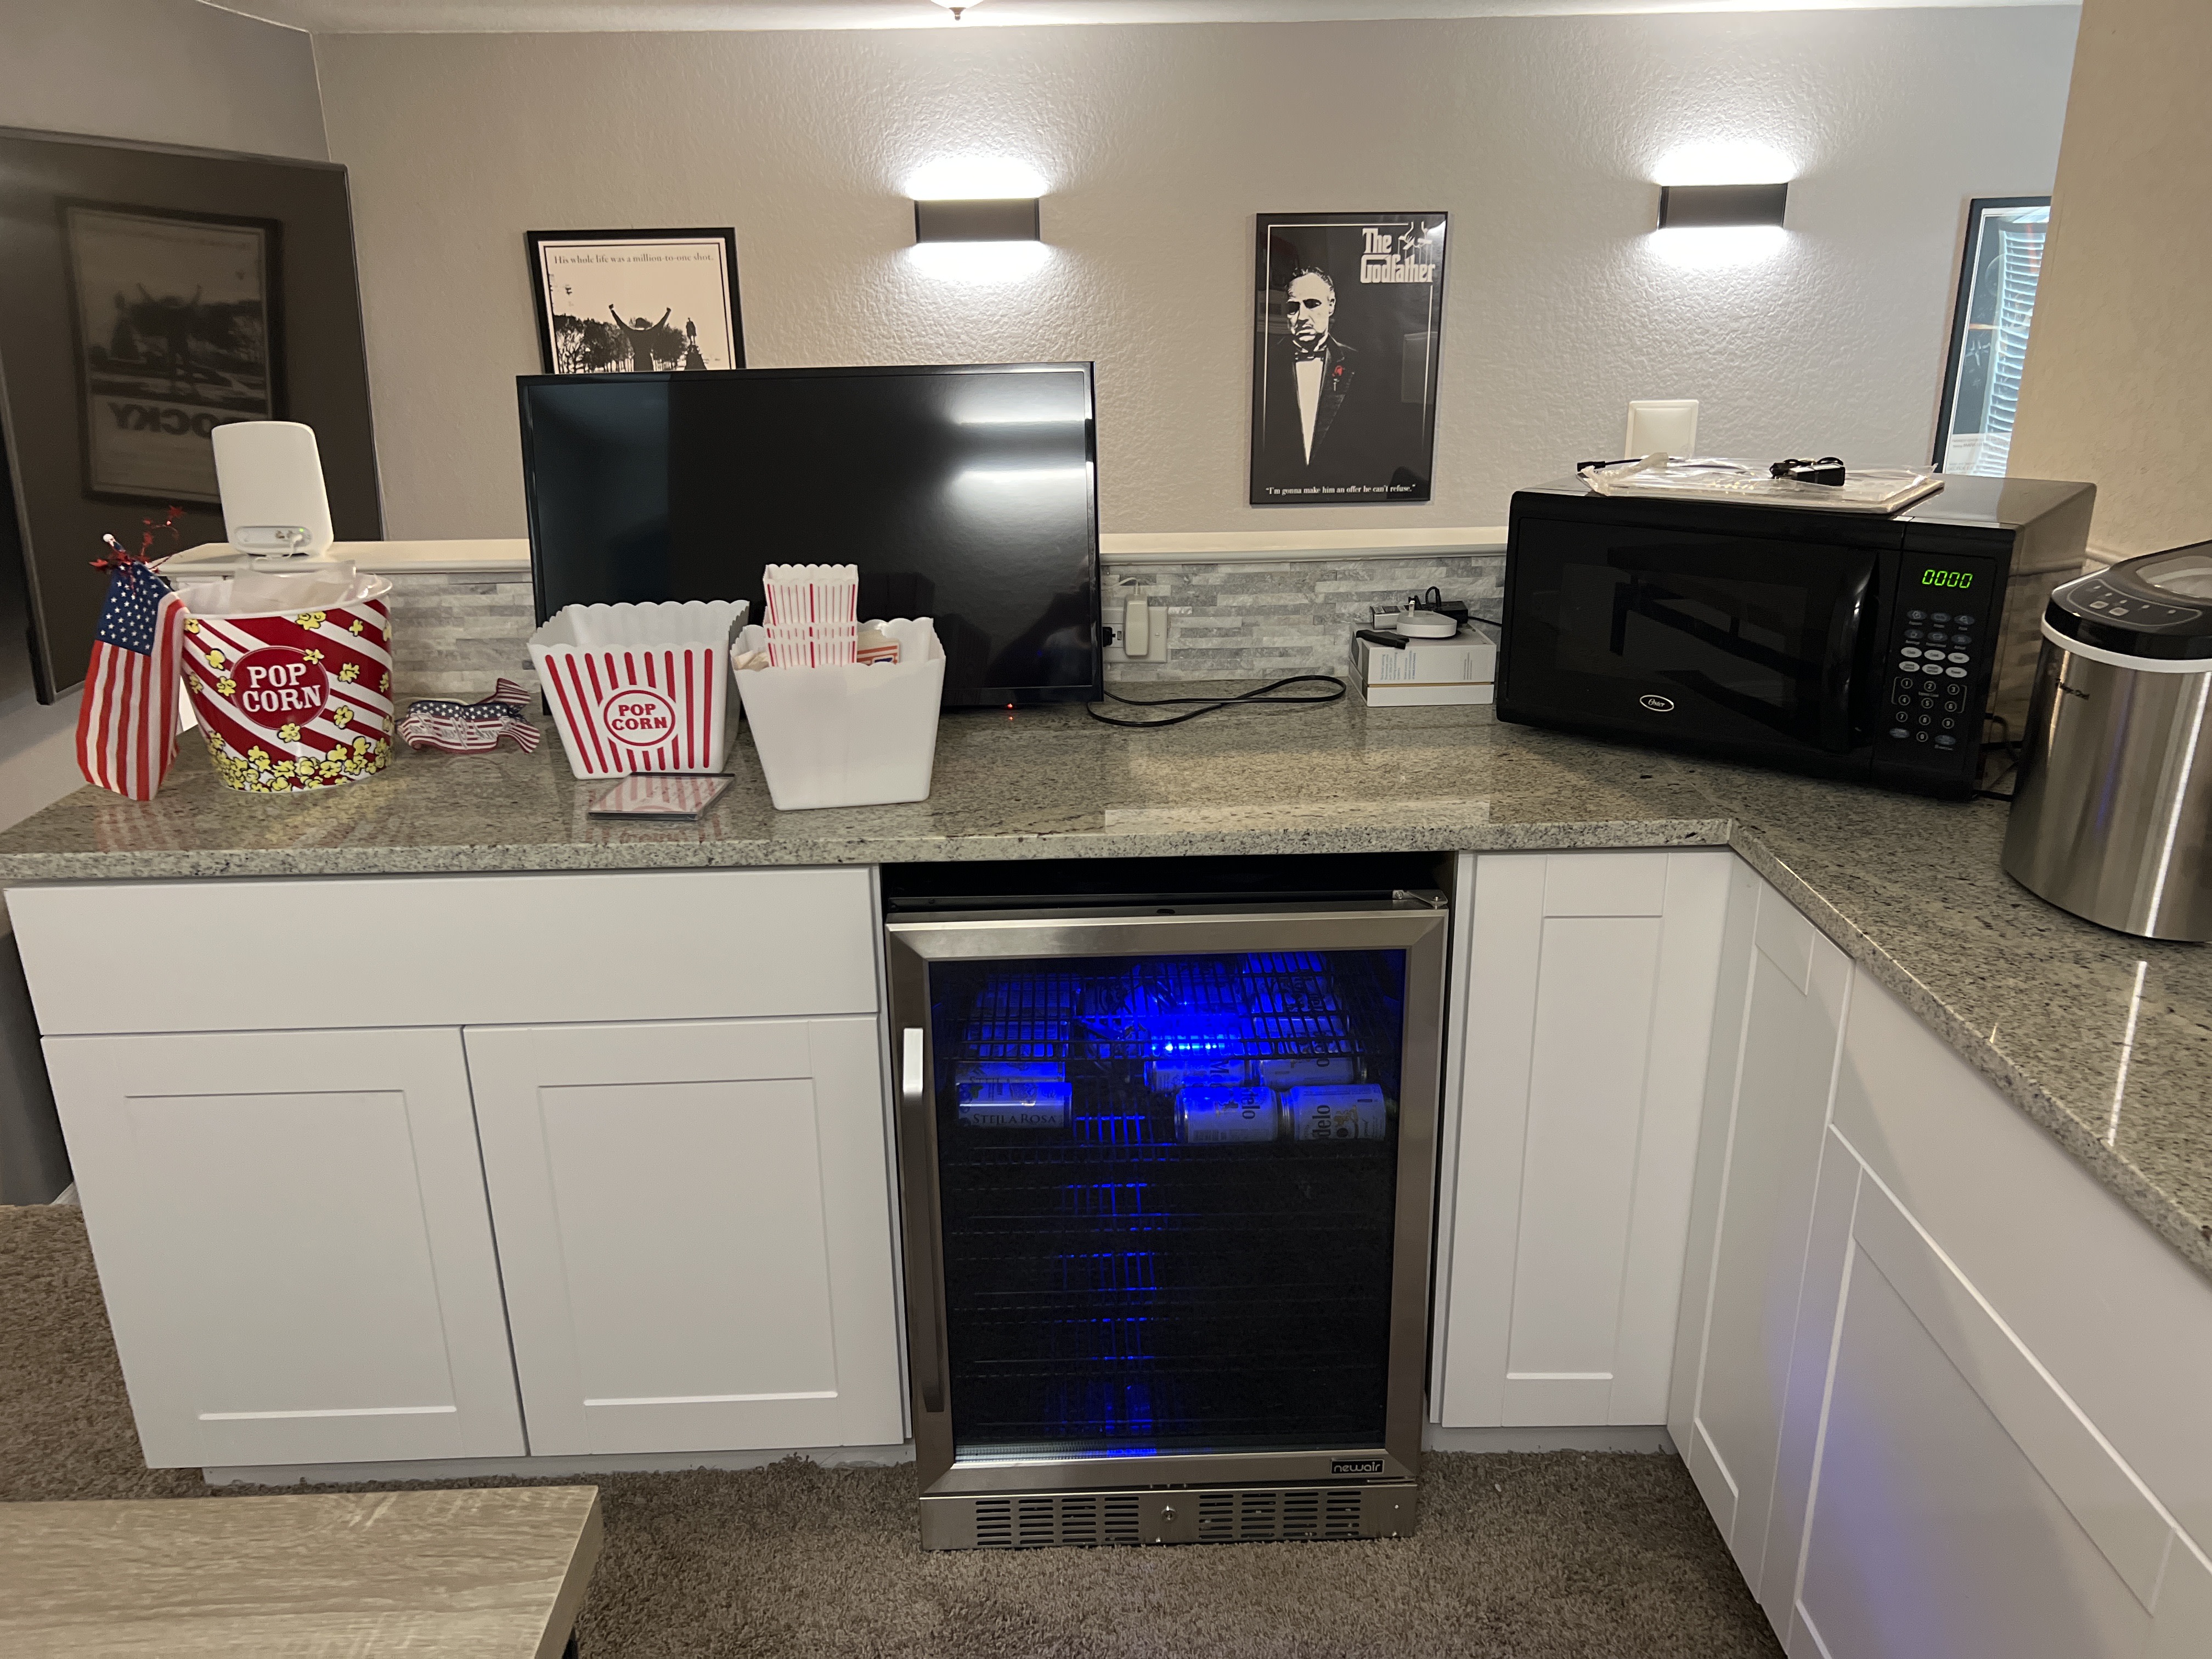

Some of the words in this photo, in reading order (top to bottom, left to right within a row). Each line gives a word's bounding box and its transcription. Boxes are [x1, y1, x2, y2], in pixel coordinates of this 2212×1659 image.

[1362, 228, 1392, 253] The
[554, 256, 569, 264] His
[571, 254, 593, 263] whole
[596, 254, 610, 263] life
[633, 253, 692, 262] million-to-one
[694, 252, 714, 261] shot.
[1360, 254, 1436, 283] Godfather
[247, 663, 307, 688] POP
[242, 685, 321, 712] CORN
[618, 703, 656, 716] POP
[612, 716, 668, 730] CORN
[1240, 1088, 1261, 1120] delo
[1020, 1113, 1056, 1124] ROSA
[1312, 1104, 1331, 1137] delo
[1334, 1461, 1381, 1472] newair
